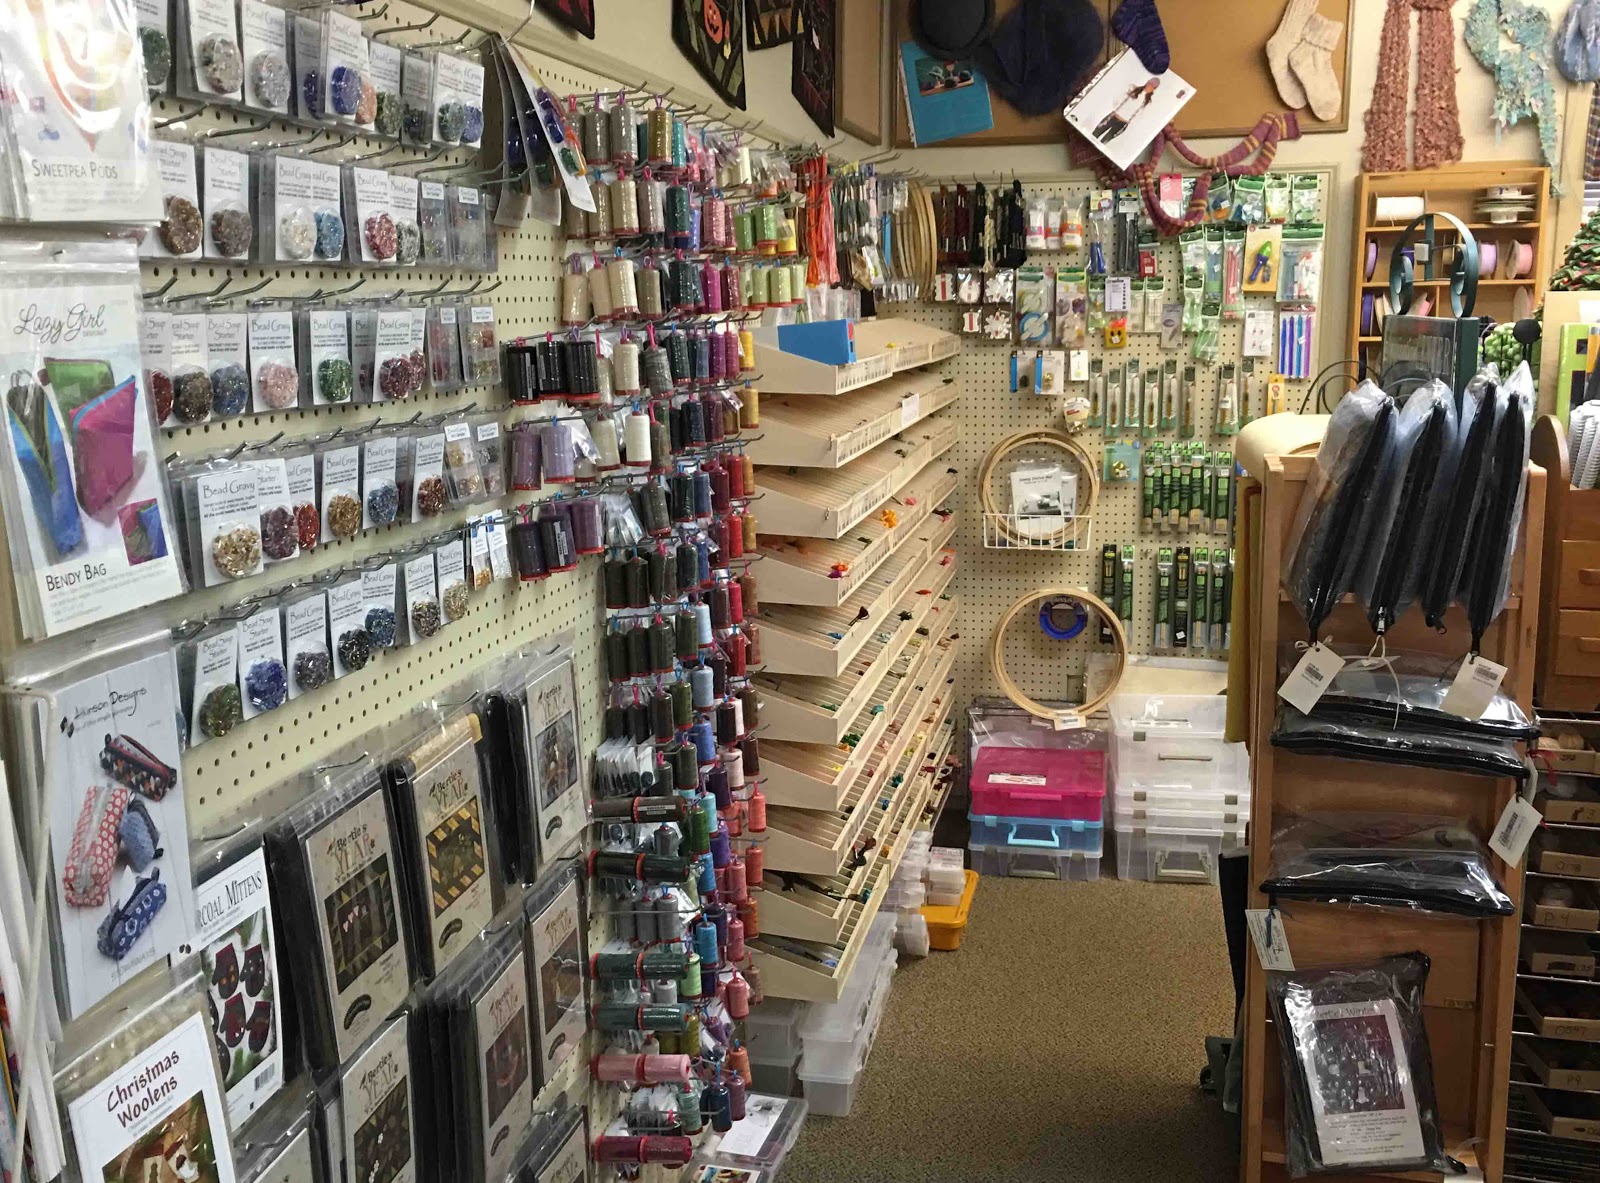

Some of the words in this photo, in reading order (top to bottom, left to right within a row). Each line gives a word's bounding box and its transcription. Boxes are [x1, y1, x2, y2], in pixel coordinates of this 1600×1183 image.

[31, 159, 87, 178] SWEETPEA
[13, 303, 65, 344] Lazy
[64, 302, 106, 342] Girl
[252, 319, 271, 333] Bead
[203, 482, 229, 499] Bead
[229, 479, 256, 494] Gravy
[46, 570, 81, 592] BENDY
[83, 563, 107, 581] BAG
[109, 687, 147, 717] Designs
[225, 871, 263, 909] MITTENS
[107, 1050, 180, 1113] Christmas
[117, 1076, 178, 1129] Woolens
